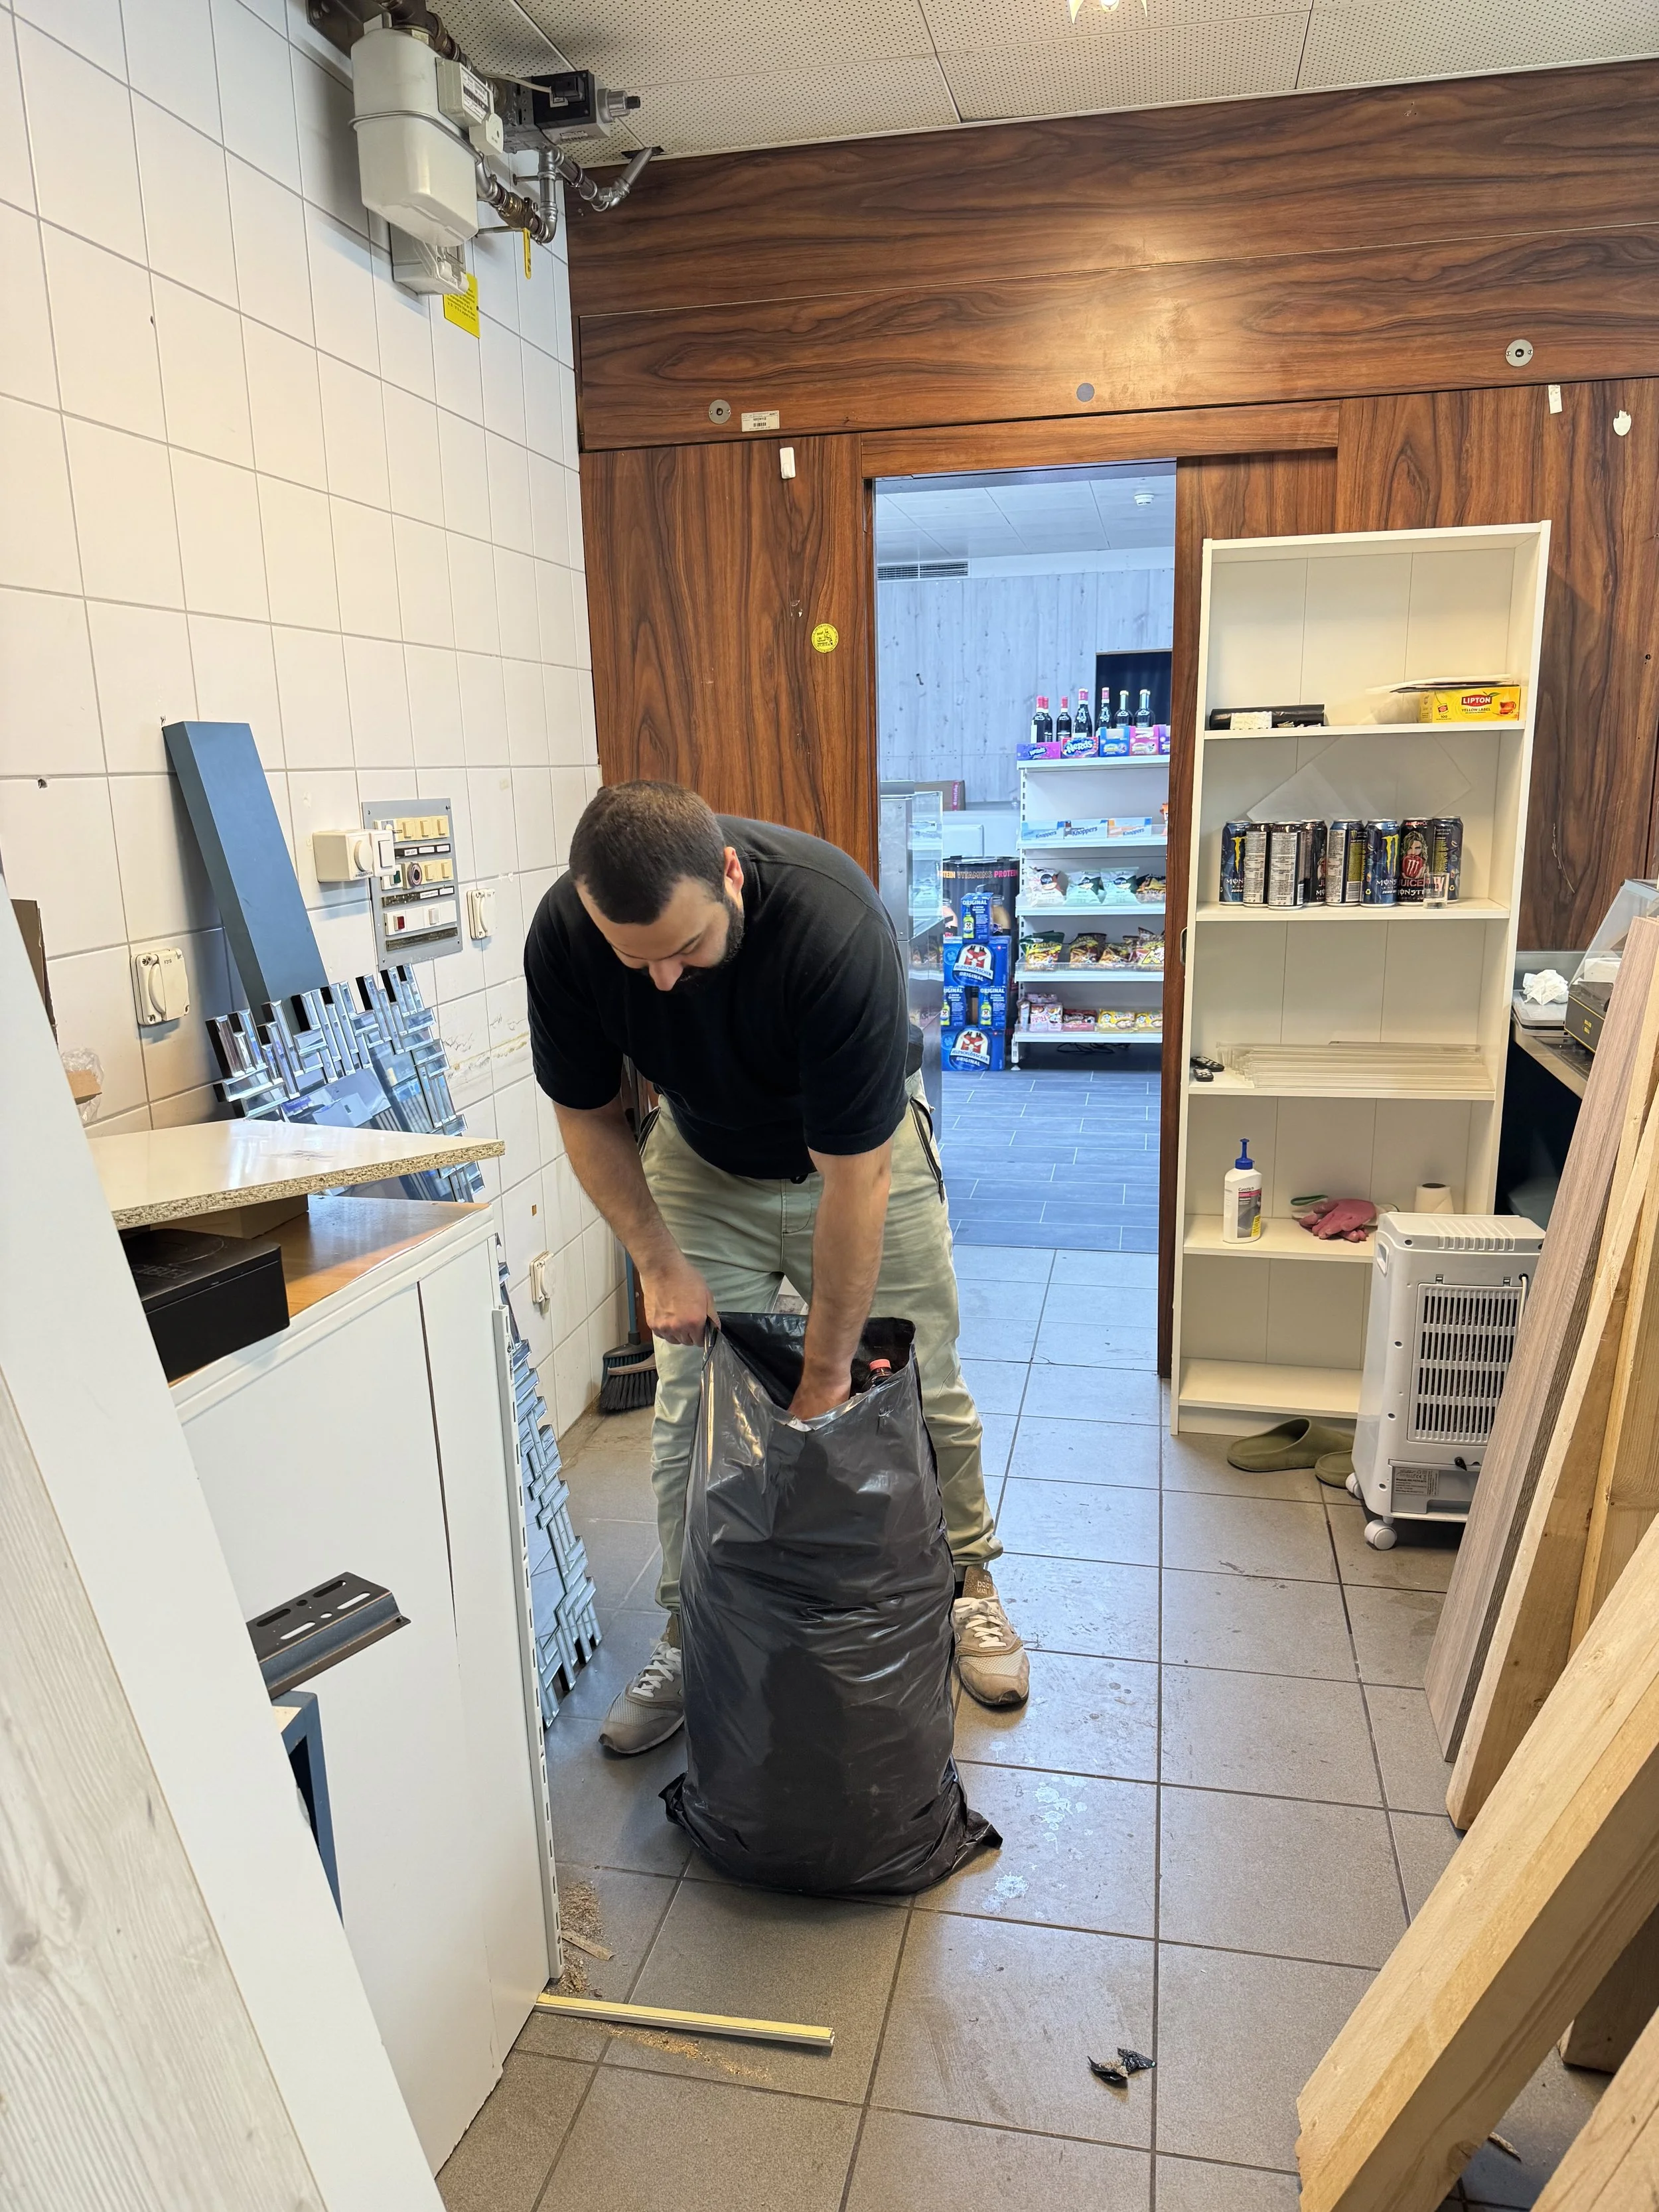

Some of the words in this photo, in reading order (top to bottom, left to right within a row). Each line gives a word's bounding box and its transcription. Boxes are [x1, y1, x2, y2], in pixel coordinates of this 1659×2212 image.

[1035, 830, 1057, 839] Knoppers
[1072, 826, 1098, 836] Knoppers
[1123, 827, 1145, 836] Knoppers
[959, 972, 984, 982] ORIGINAL
[956, 1057, 981, 1067] ORIGINAL
